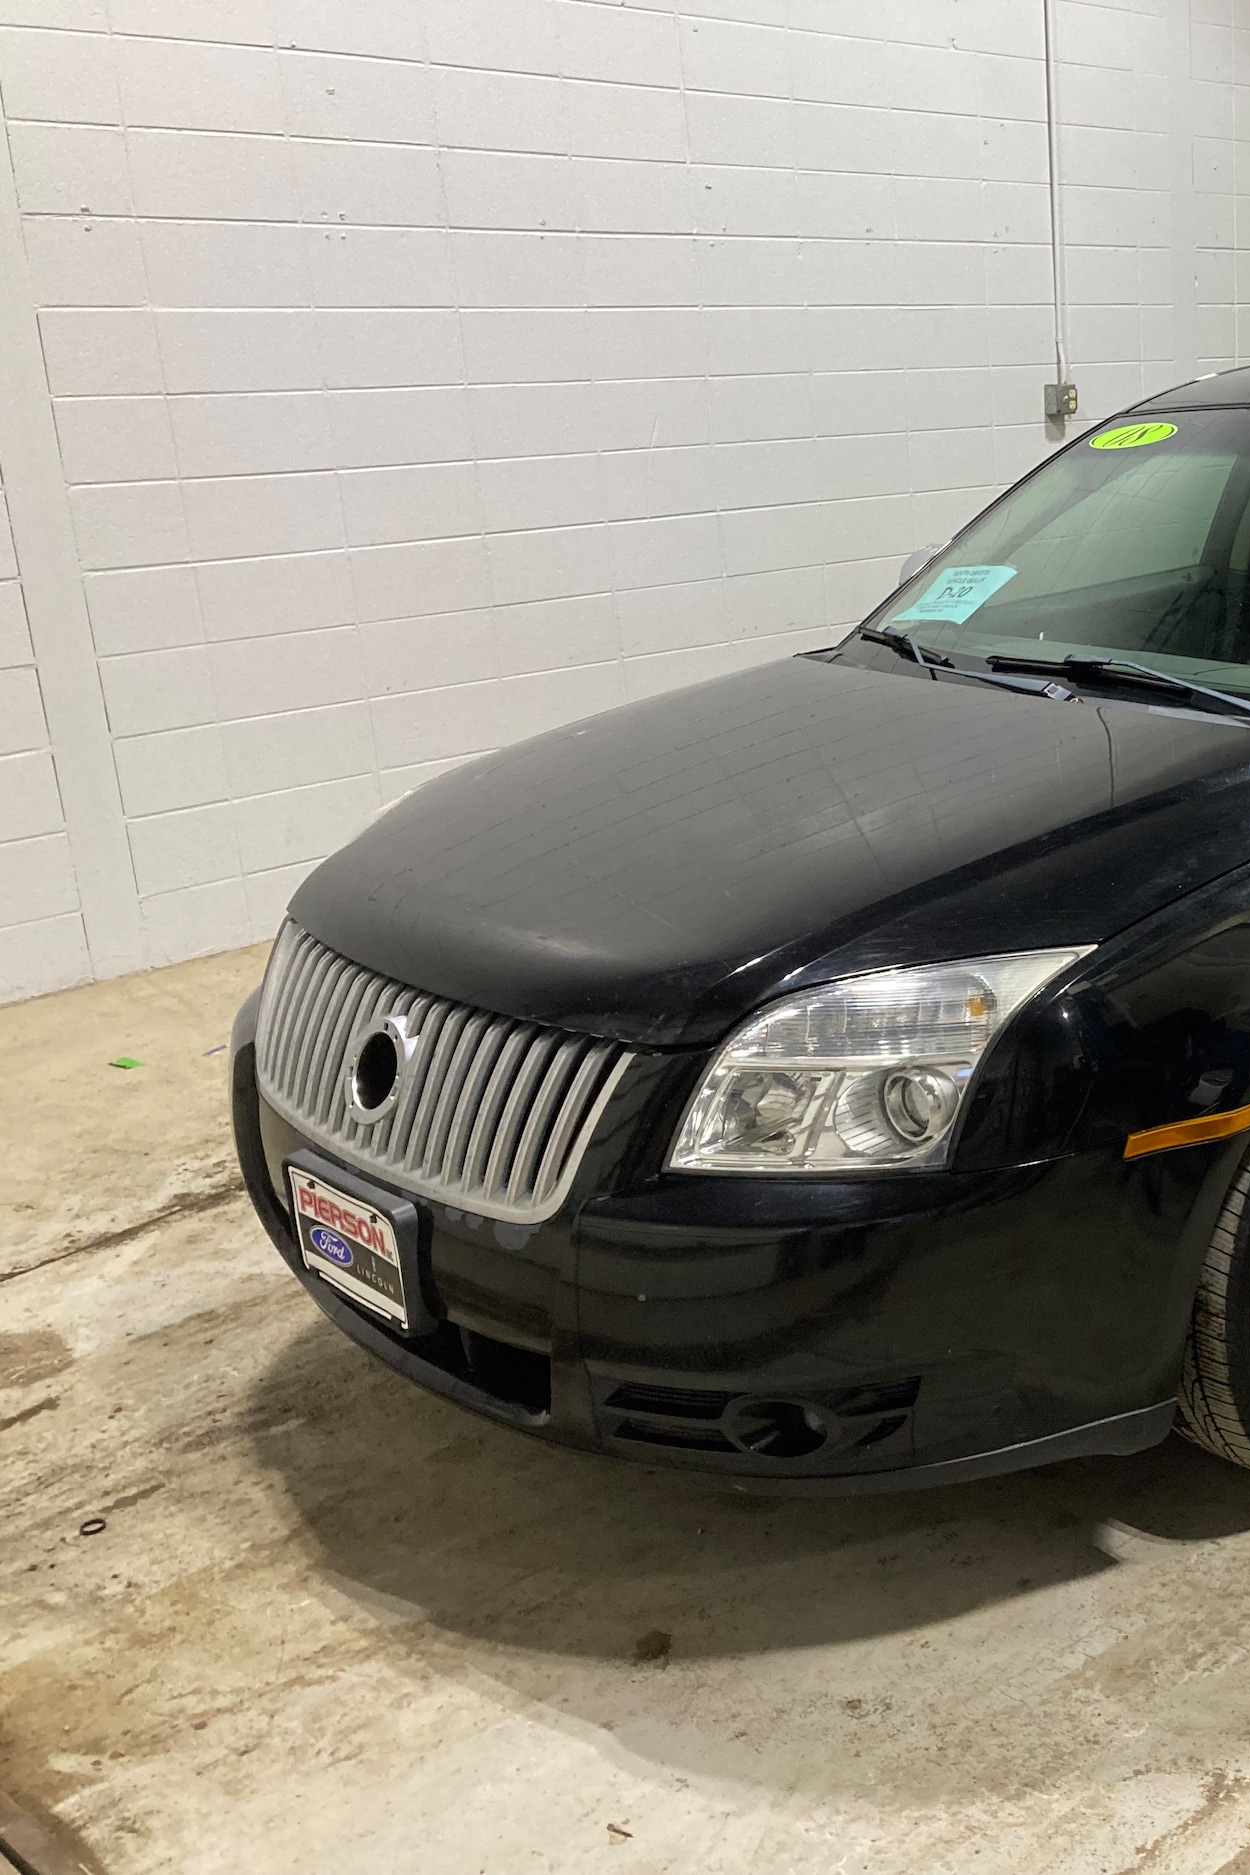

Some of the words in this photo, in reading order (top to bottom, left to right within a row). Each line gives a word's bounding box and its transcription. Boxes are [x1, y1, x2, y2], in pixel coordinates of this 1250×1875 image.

[299, 1187, 386, 1255] PIERSON
[319, 1231, 345, 1260] Ford
[357, 1265, 395, 1294] LINCOLN
